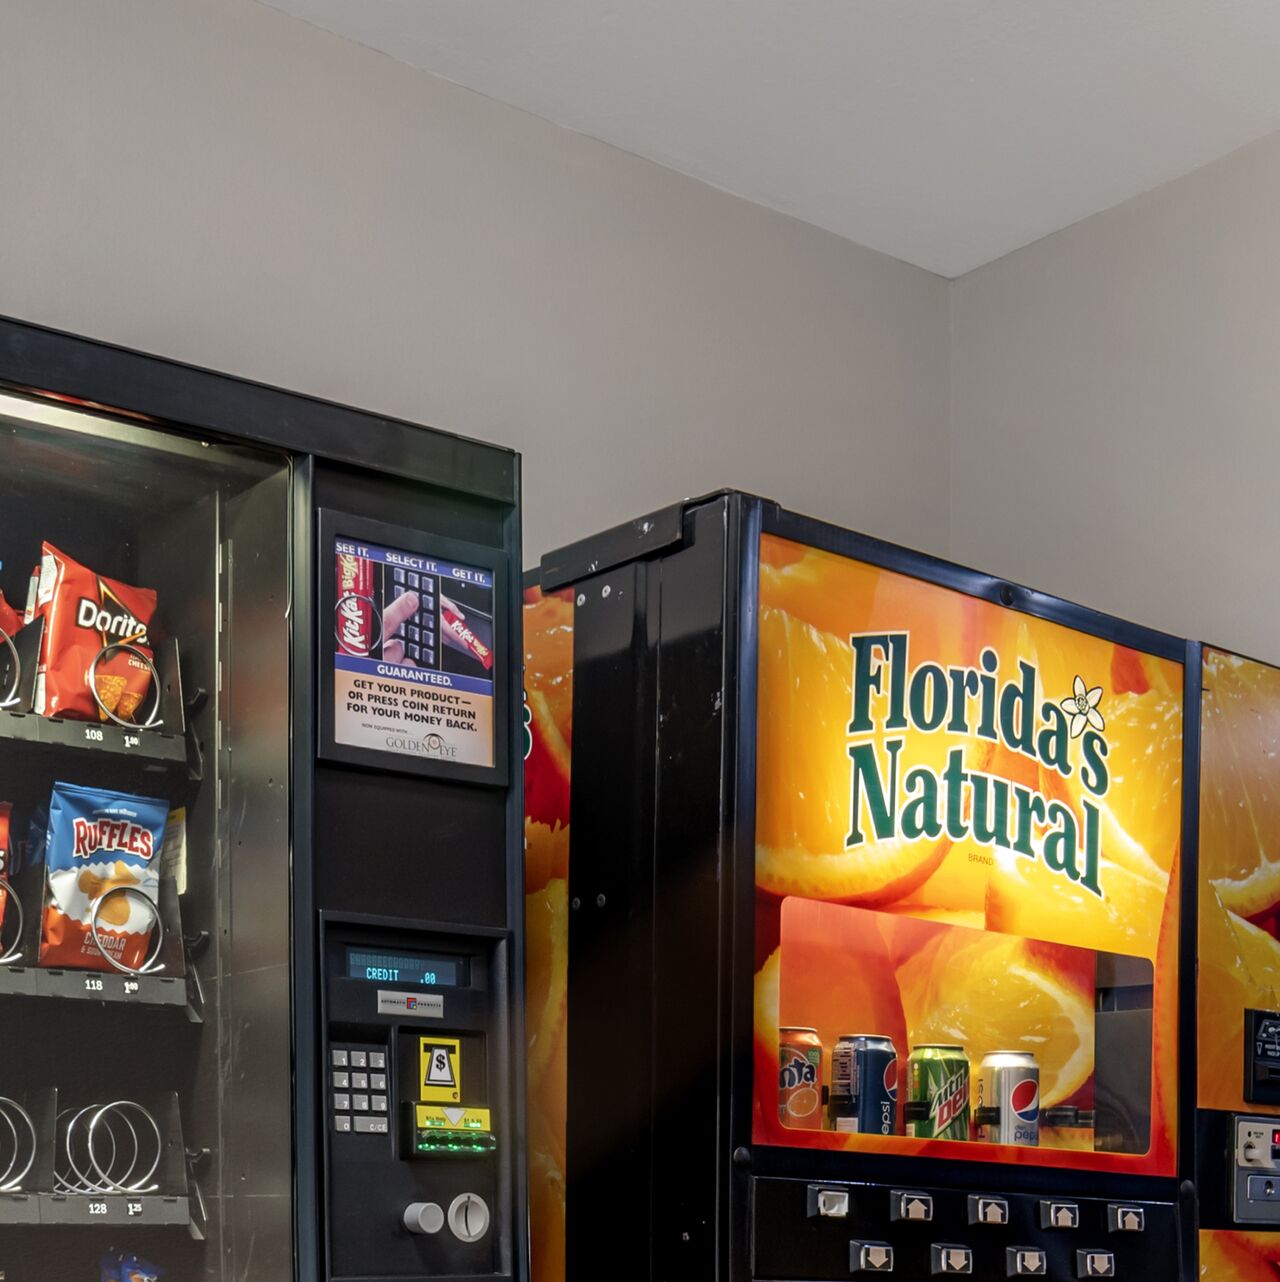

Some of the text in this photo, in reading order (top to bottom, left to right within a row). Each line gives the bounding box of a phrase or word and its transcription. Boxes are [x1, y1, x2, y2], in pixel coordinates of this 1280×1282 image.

[336, 542, 369, 558] SEE IT.
[386, 552, 438, 573] SELECT IT.
[452, 567, 486, 584] GET IT.
[77, 598, 151, 645] Dorito
[377, 665, 453, 687] GUARANTEED.
[354, 679, 374, 690] GET
[377, 682, 407, 695] YOUR
[348, 690, 476, 720] OR PRESS COIN RETURN
[847, 630, 1111, 797] Florida's
[347, 702, 478, 732] FOR YOUR MONEY BACK.
[85, 729, 103, 741] 108
[386, 736, 430, 756] GOLDEN
[844, 739, 1105, 898] Natural
[73, 816, 154, 859] RUFFLES
[968, 853, 993, 866] BRAND
[366, 967, 400, 982] CREDIT
[84, 980, 103, 991] 118
[779, 1059, 816, 1089] nta
[369, 1123, 386, 1131] C/CE
[881, 1100, 890, 1135] epsi
[89, 1203, 108, 1215] 128
